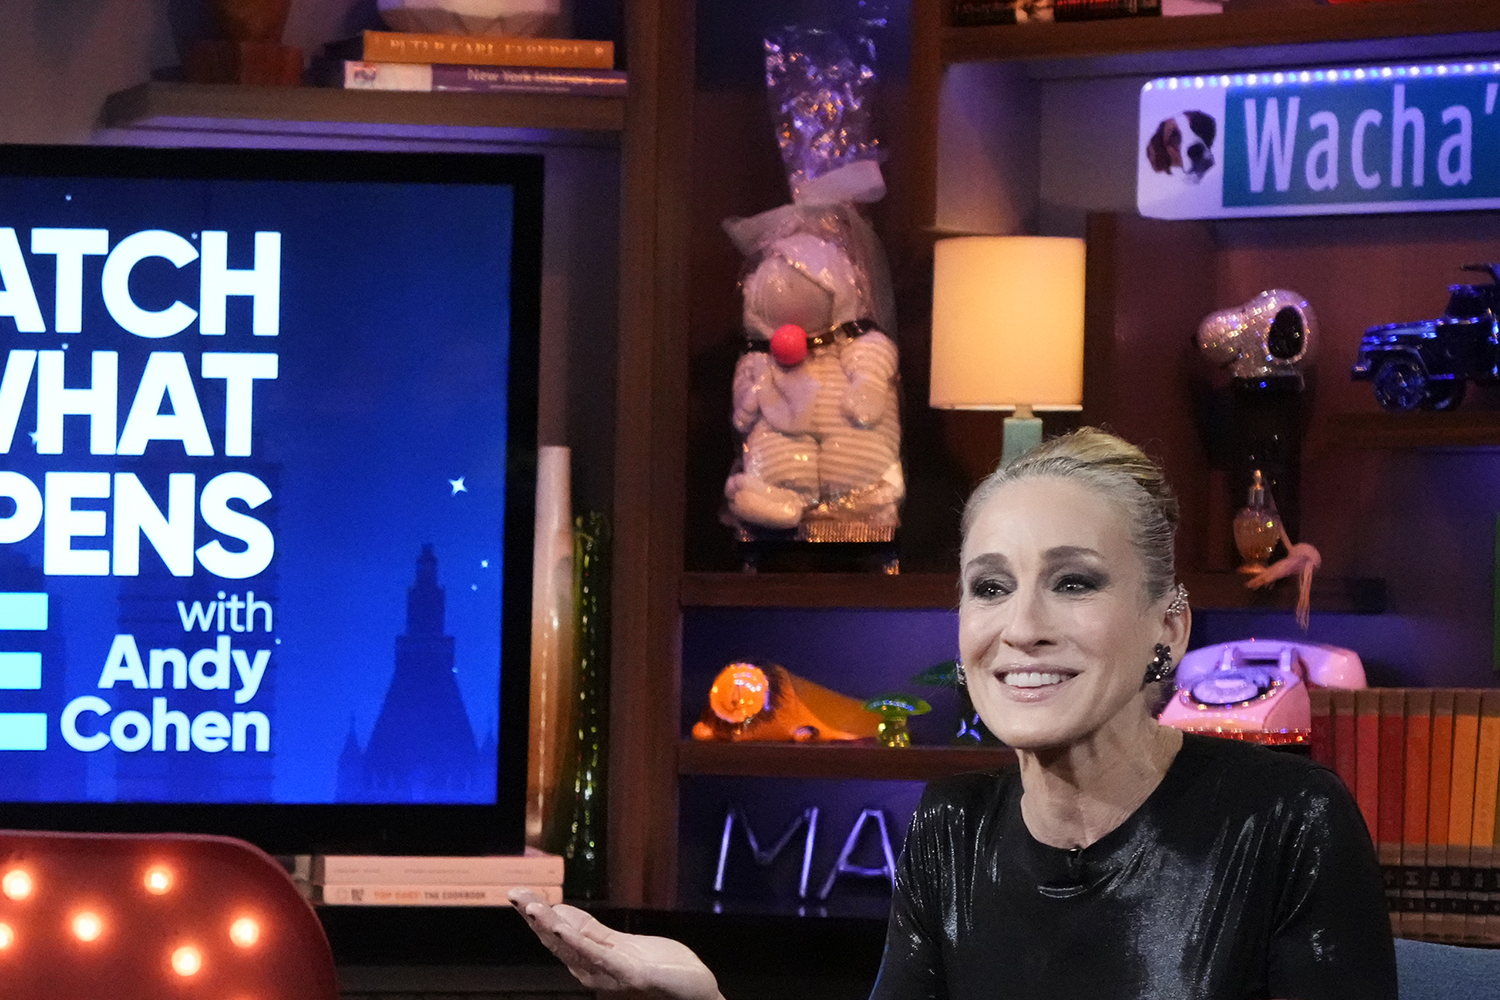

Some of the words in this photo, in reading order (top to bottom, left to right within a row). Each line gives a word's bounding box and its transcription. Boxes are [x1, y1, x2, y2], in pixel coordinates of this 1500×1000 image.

[177, 591, 273, 633] with
[98, 634, 271, 704] Andy
[60, 695, 271, 752] Cohen
